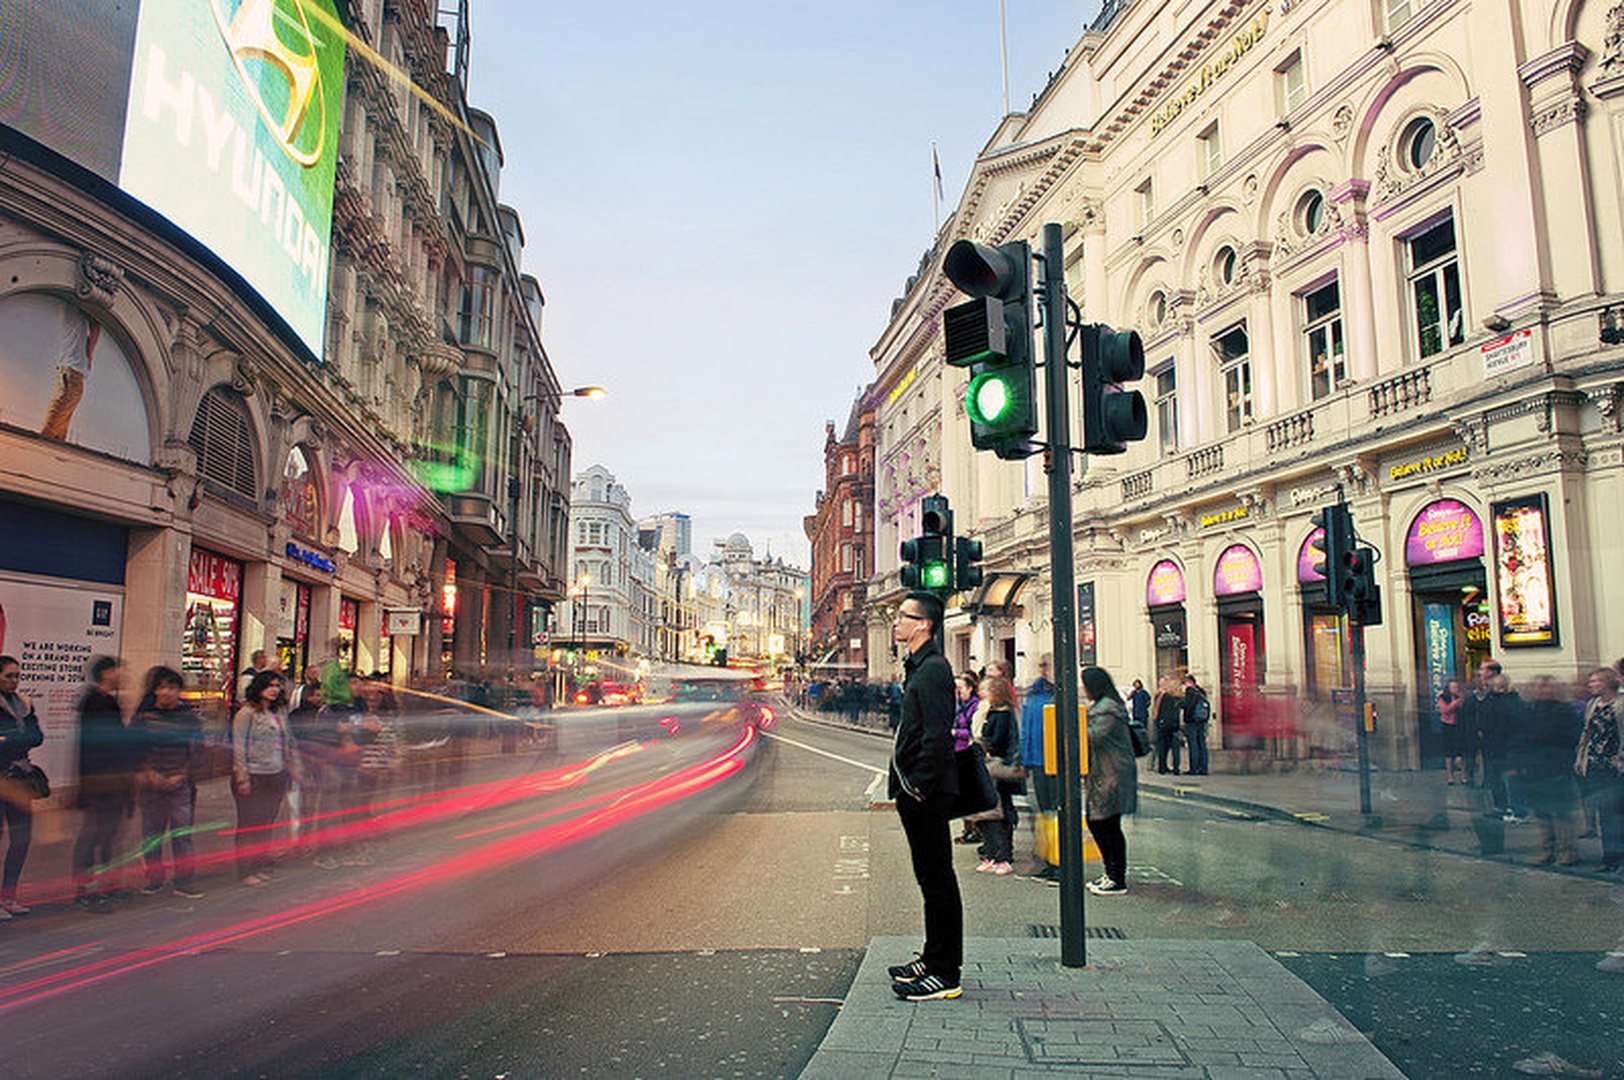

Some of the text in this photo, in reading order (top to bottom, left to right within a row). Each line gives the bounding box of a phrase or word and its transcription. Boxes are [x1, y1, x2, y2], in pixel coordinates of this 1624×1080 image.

[1150, 86, 1198, 140] Believe
[143, 43, 327, 299] HYUNDAI
[1486, 355, 1509, 369] AVENUE
[1389, 463, 1421, 479] Believe
[1433, 456, 1445, 468] or
[1445, 446, 1468, 463] Not!
[1418, 519, 1458, 537] Believe
[1424, 531, 1465, 551] or Not!
[190, 552, 217, 596] SALE
[22, 652, 34, 660] ON
[44, 653, 70, 662] BRAND
[23, 642, 92, 654] WE ARE WORKING
[21, 663, 82, 673] EXCITING STORE
[20, 673, 55, 682] OPENING
[57, 674, 65, 682] IN
